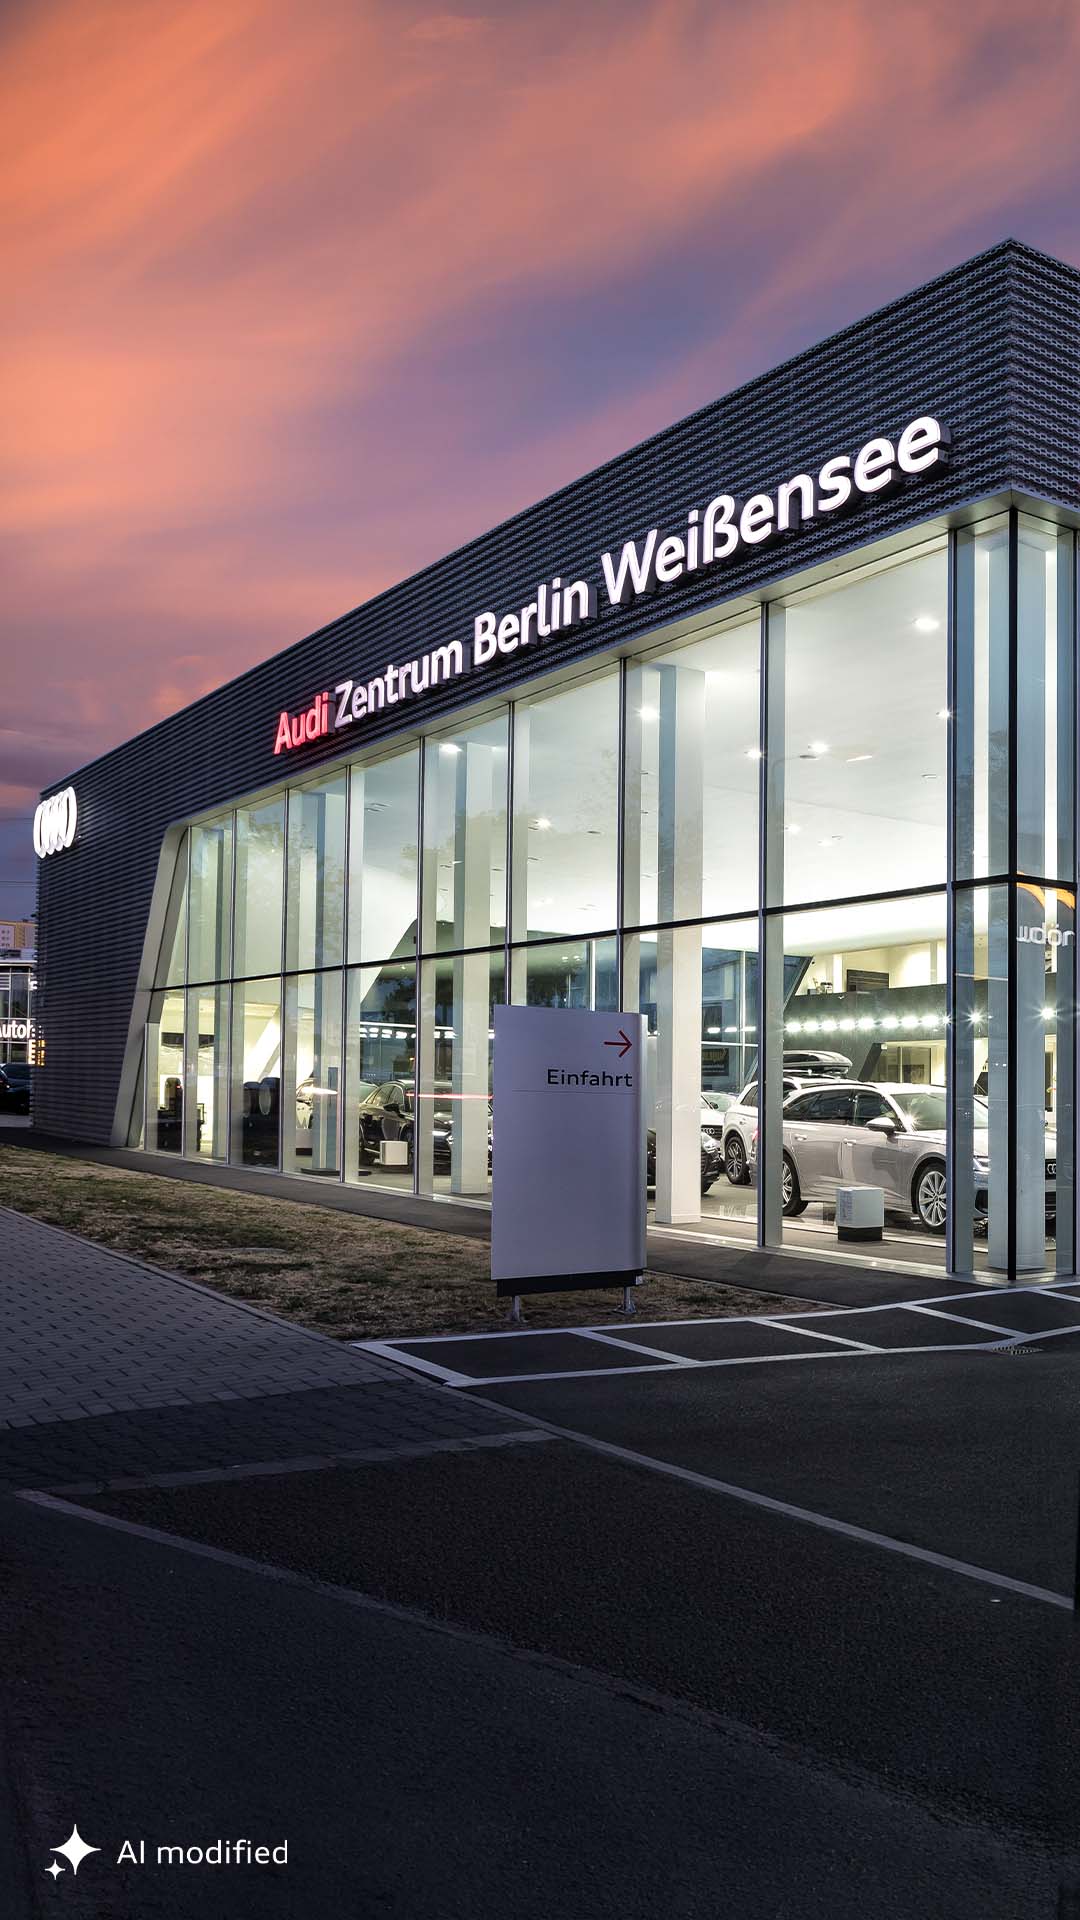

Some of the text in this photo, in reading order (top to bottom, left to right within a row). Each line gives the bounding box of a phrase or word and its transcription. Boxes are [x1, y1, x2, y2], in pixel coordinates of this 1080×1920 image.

[273, 416, 941, 754] Audi Zentrum Berlin Weißensee
[547, 1069, 633, 1087] Einfahrt
